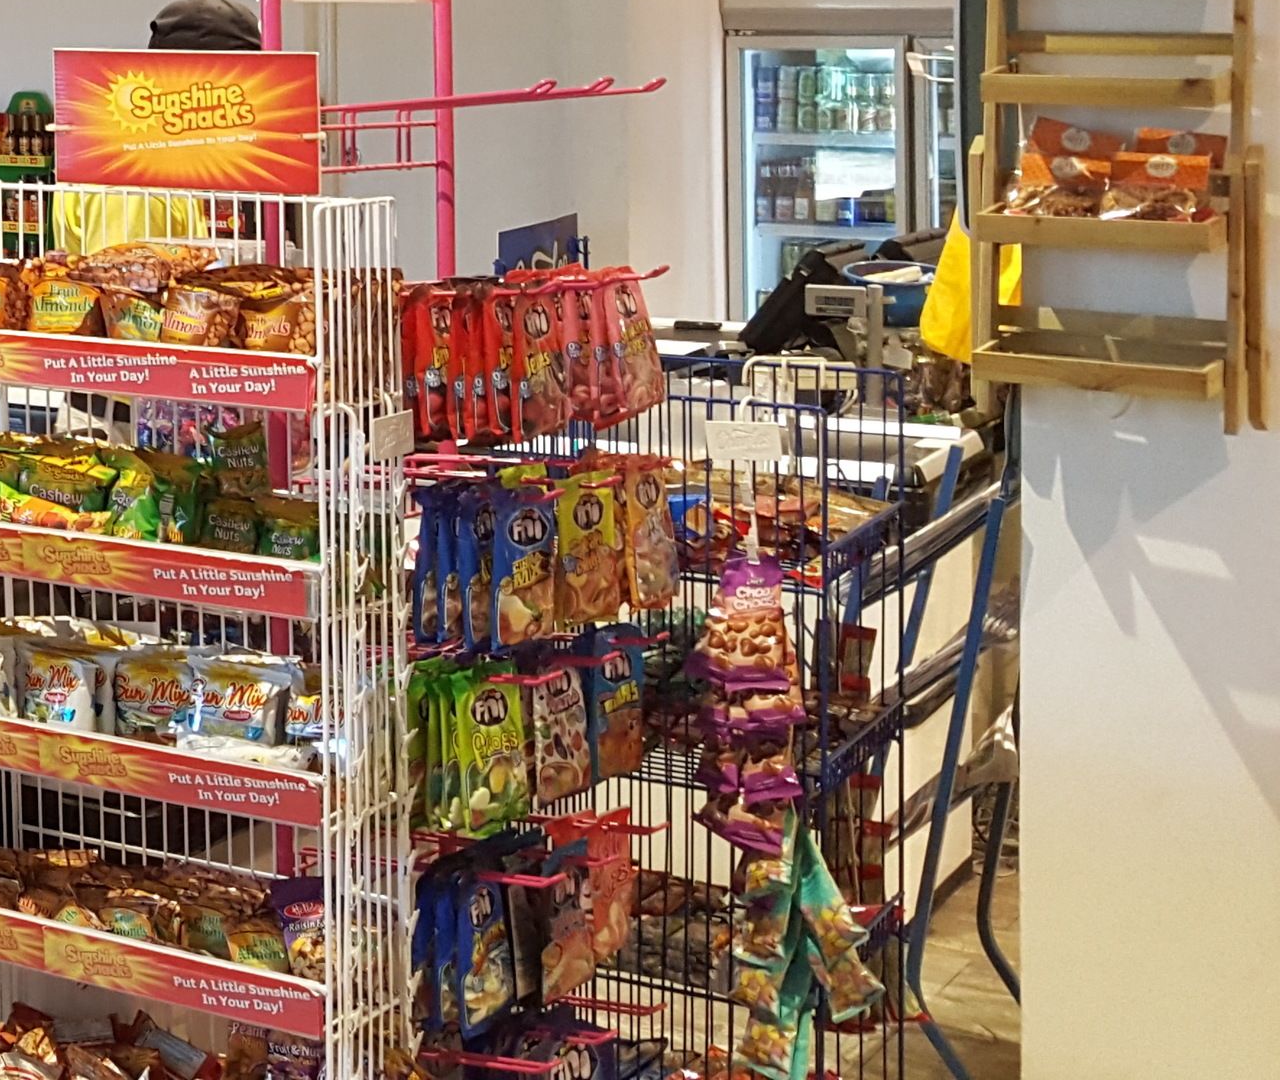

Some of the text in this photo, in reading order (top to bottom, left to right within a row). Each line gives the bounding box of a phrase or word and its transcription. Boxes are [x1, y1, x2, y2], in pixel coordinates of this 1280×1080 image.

[129, 80, 246, 119] Sunshine
[161, 104, 256, 136] Snacks
[43, 353, 178, 369] Put A Little Sunshine
[70, 369, 150, 385] In Your Day!
[189, 362, 308, 379] A Little Sunshine
[191, 379, 277, 396] In Your Day!
[217, 444, 260, 457] Cashew
[227, 457, 255, 469] Nuts
[29, 483, 84, 505] Cashew
[208, 514, 251, 531] Cashew
[214, 527, 241, 542] Nuts
[43, 545, 106, 565] Sunshine
[271, 543, 292, 556] Nuts
[61, 558, 113, 576] Snacks
[153, 567, 293, 583] Put A Little Sunshine
[182, 583, 266, 599] In Your Day!
[48, 664, 79, 692] Mix
[115, 675, 191, 706] Sun Mix
[223, 681, 267, 710] Mix
[474, 691, 506, 725] Fini
[59, 746, 122, 765] Sunshine
[78, 761, 128, 777] Snacks
[168, 772, 307, 792] Put A Little Sunshine
[197, 788, 280, 808] In Your Day!
[65, 943, 127, 965] Sunshine
[82, 961, 133, 979] Snacks
[172, 975, 312, 1001] Put A Little Sunshine
[202, 994, 284, 1016] In Your Day!
[290, 1042, 301, 1055] &
